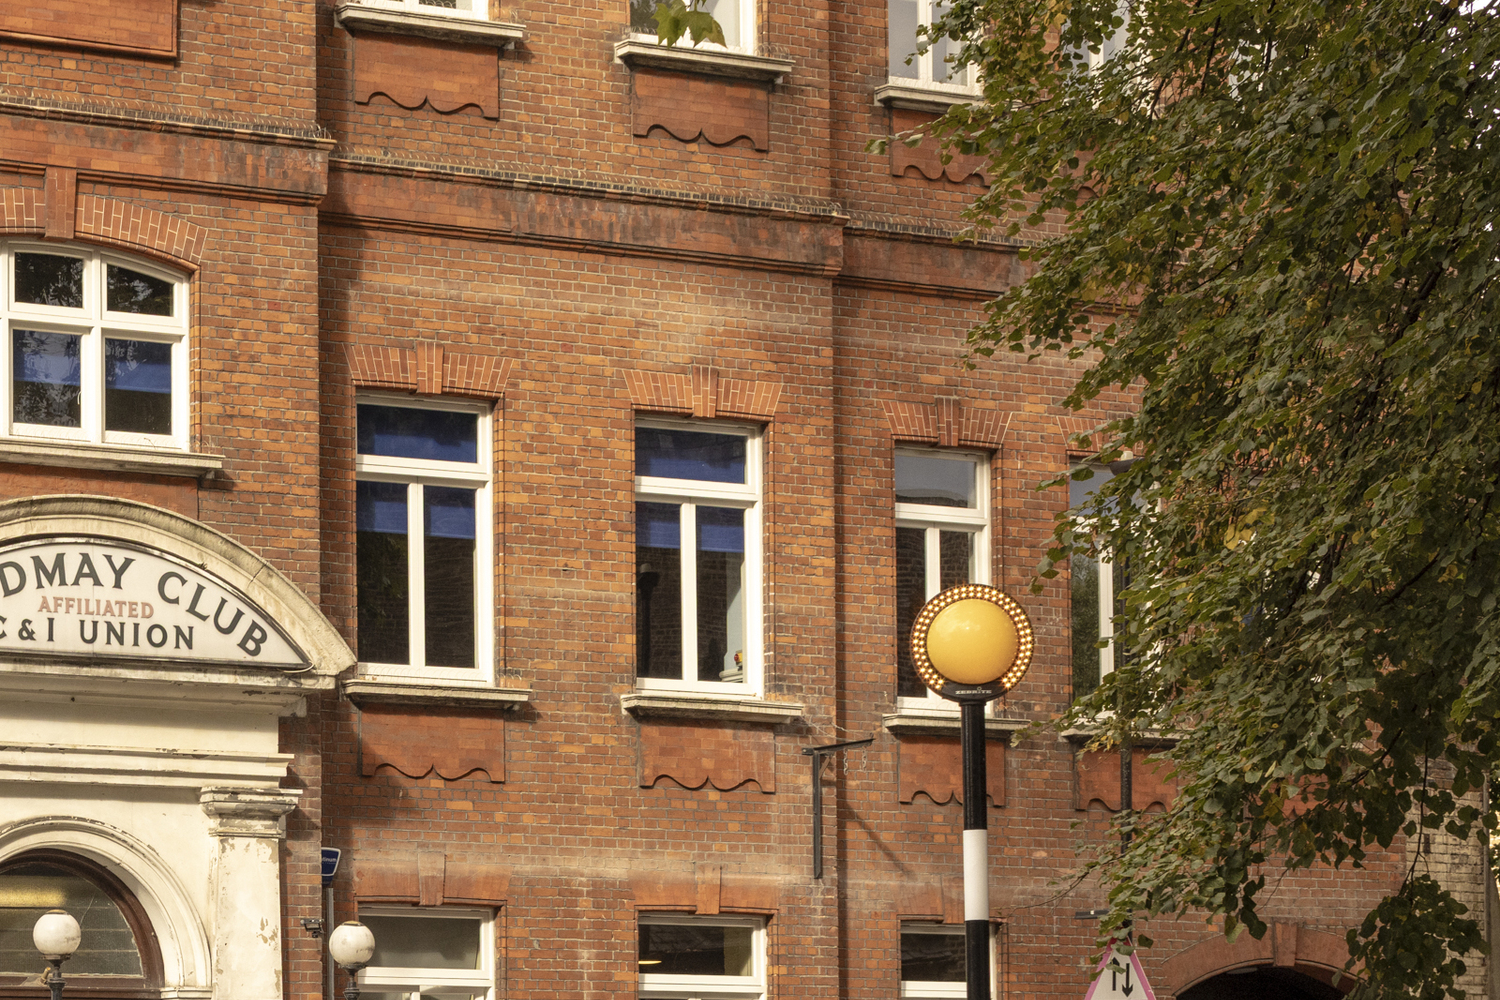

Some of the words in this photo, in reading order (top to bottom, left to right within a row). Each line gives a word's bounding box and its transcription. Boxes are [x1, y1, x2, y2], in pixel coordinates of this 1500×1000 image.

[37, 595, 154, 619] AFFILIATED
[157, 571, 268, 657] CLUB
[18, 618, 36, 641] &
[47, 617, 55, 642] I
[79, 619, 194, 650] UNION
